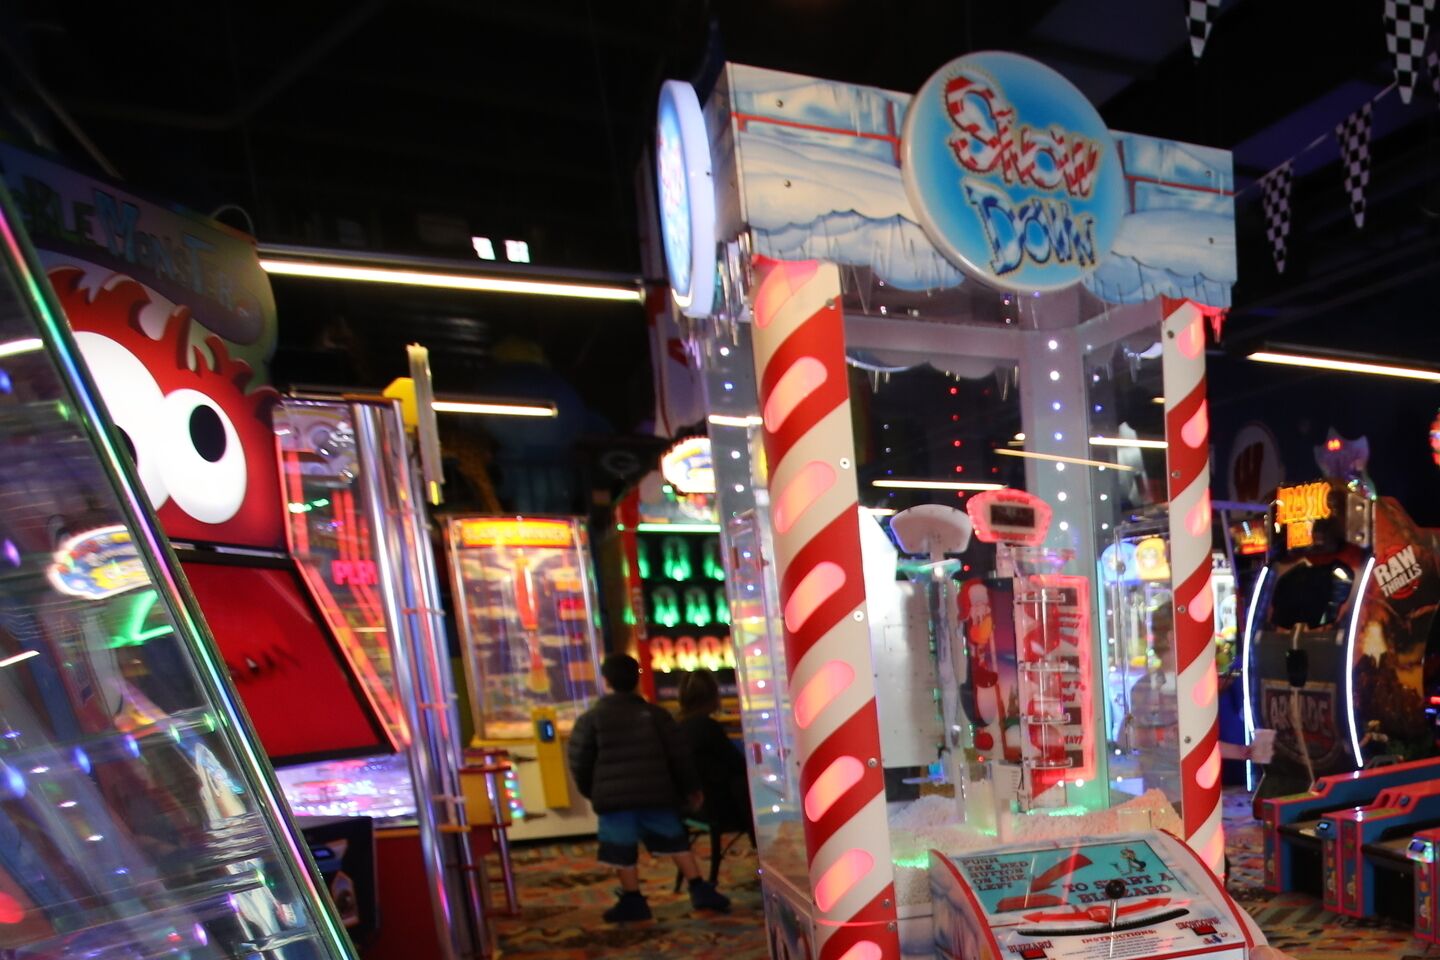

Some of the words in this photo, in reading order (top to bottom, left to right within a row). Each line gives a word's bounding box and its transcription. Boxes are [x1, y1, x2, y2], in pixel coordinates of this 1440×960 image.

[964, 181, 1096, 276] DOWN
[1372, 544, 1417, 587] RAW
[1380, 562, 1423, 599] THRILLS
[1160, 872, 1175, 881] A
